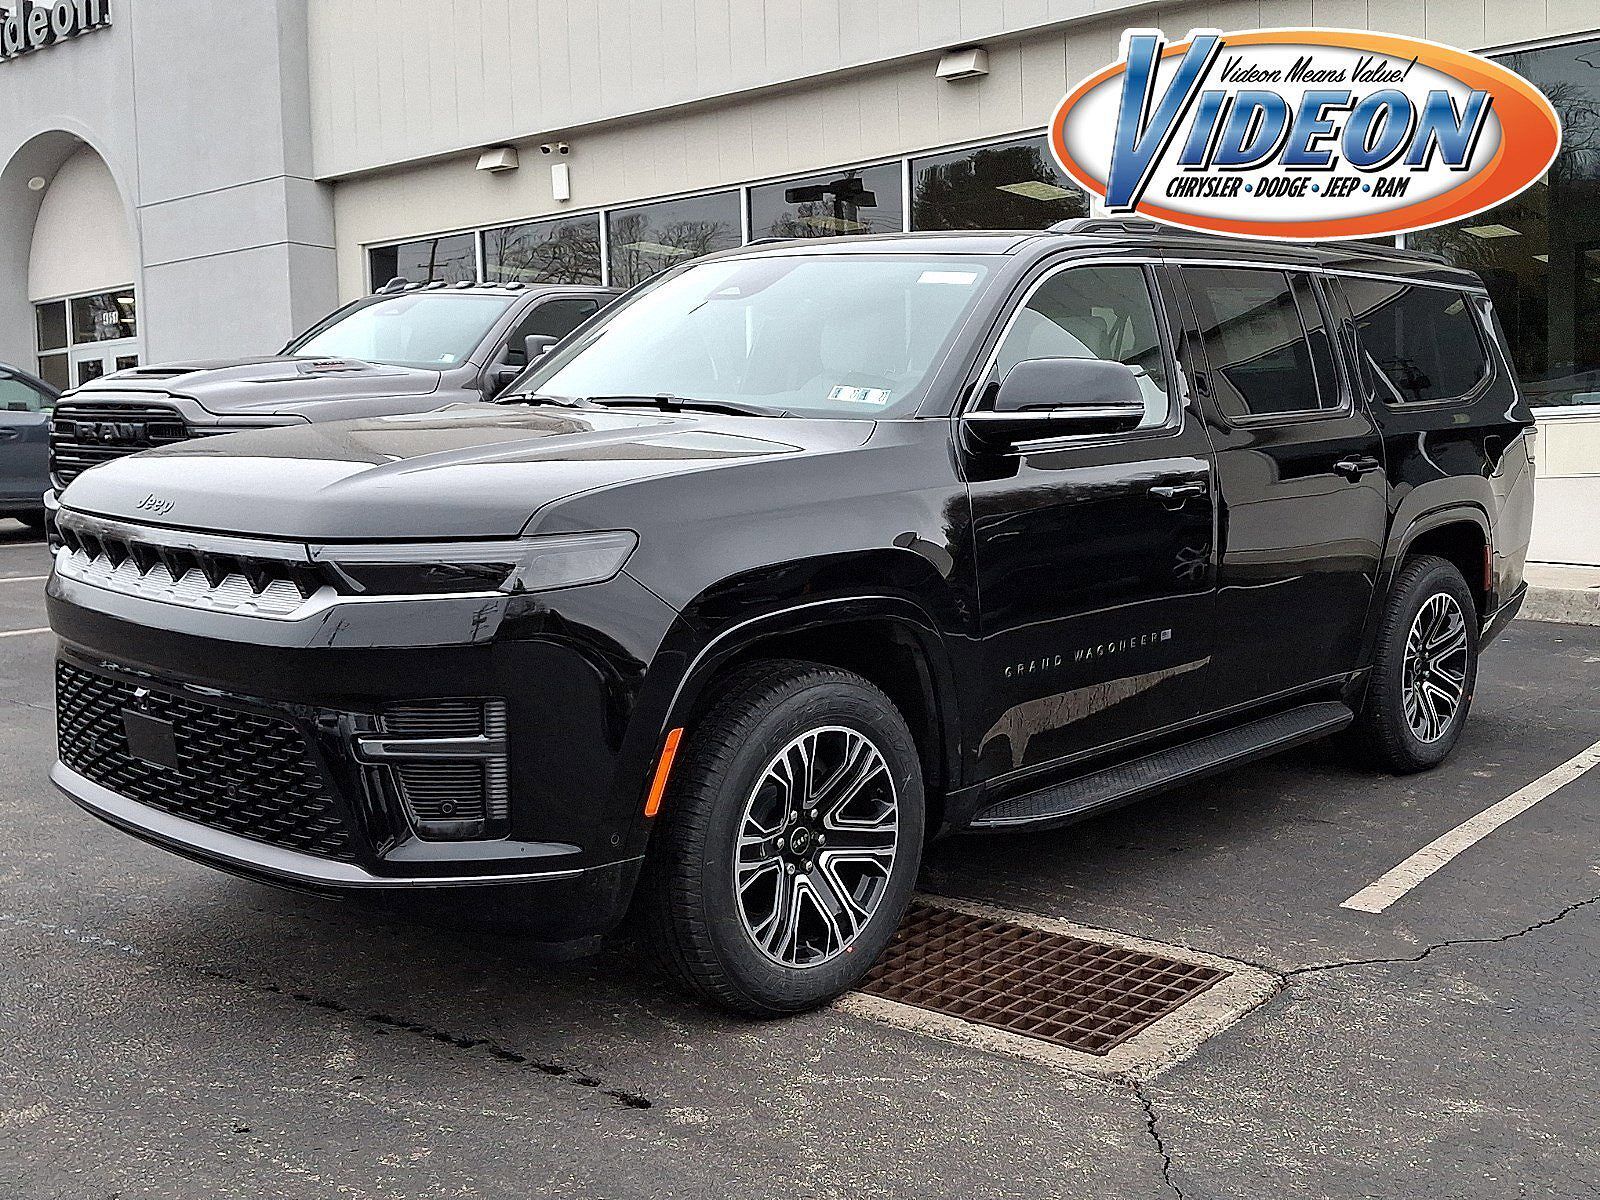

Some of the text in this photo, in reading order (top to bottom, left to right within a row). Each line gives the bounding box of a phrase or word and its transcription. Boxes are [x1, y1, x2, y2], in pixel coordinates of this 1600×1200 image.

[0, 0, 102, 54] deon
[75, 421, 146, 440] RAM
[136, 493, 175, 516] Jeep
[1004, 631, 1158, 678] GRAND WAGONEER
